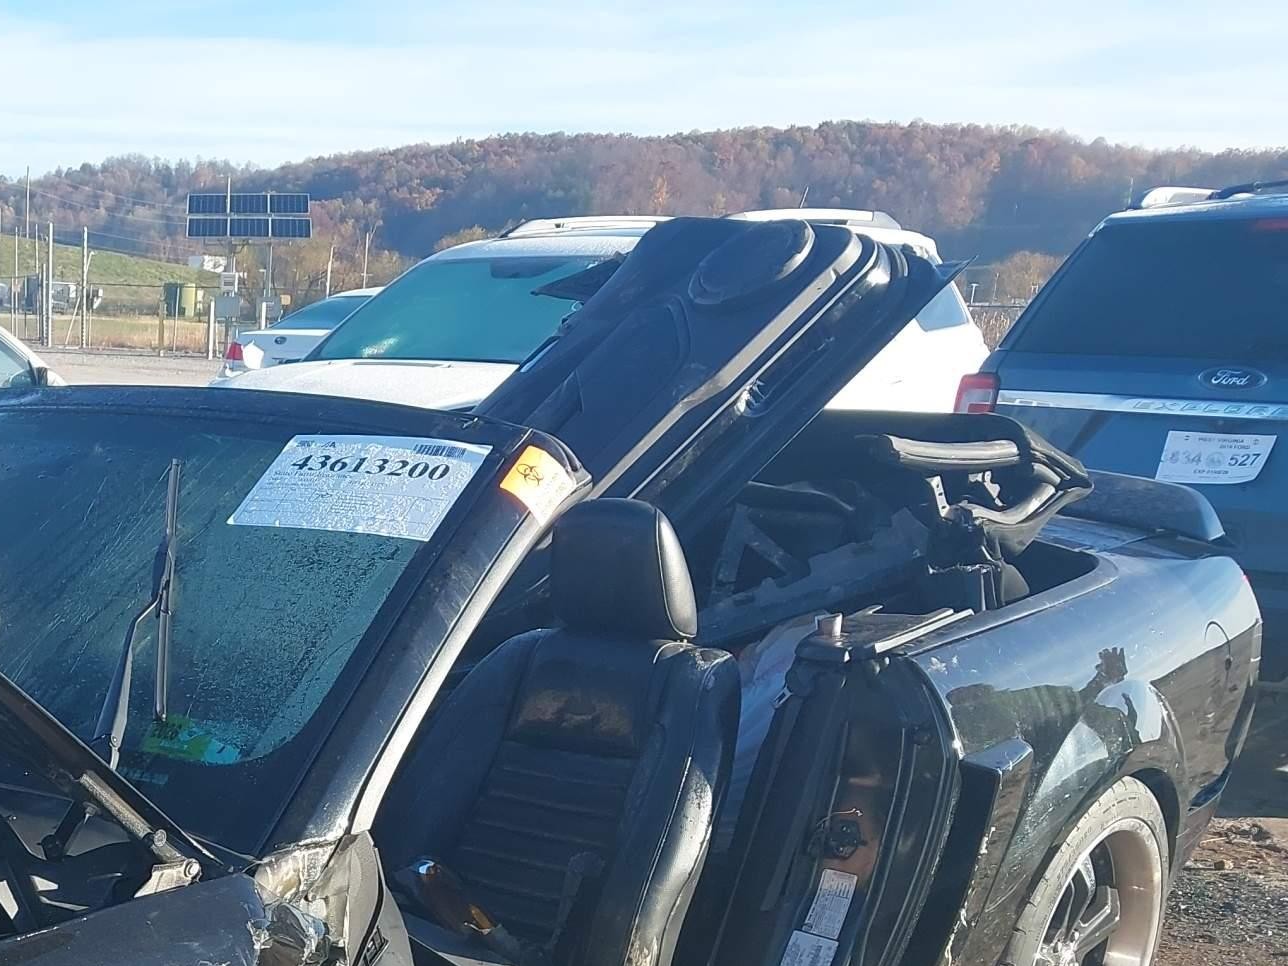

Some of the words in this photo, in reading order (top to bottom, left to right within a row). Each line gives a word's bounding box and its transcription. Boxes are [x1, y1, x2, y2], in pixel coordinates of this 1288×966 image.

[1211, 369, 1251, 386] Ford
[291, 454, 450, 481] 43613200
[1228, 453, 1262, 467] 527
